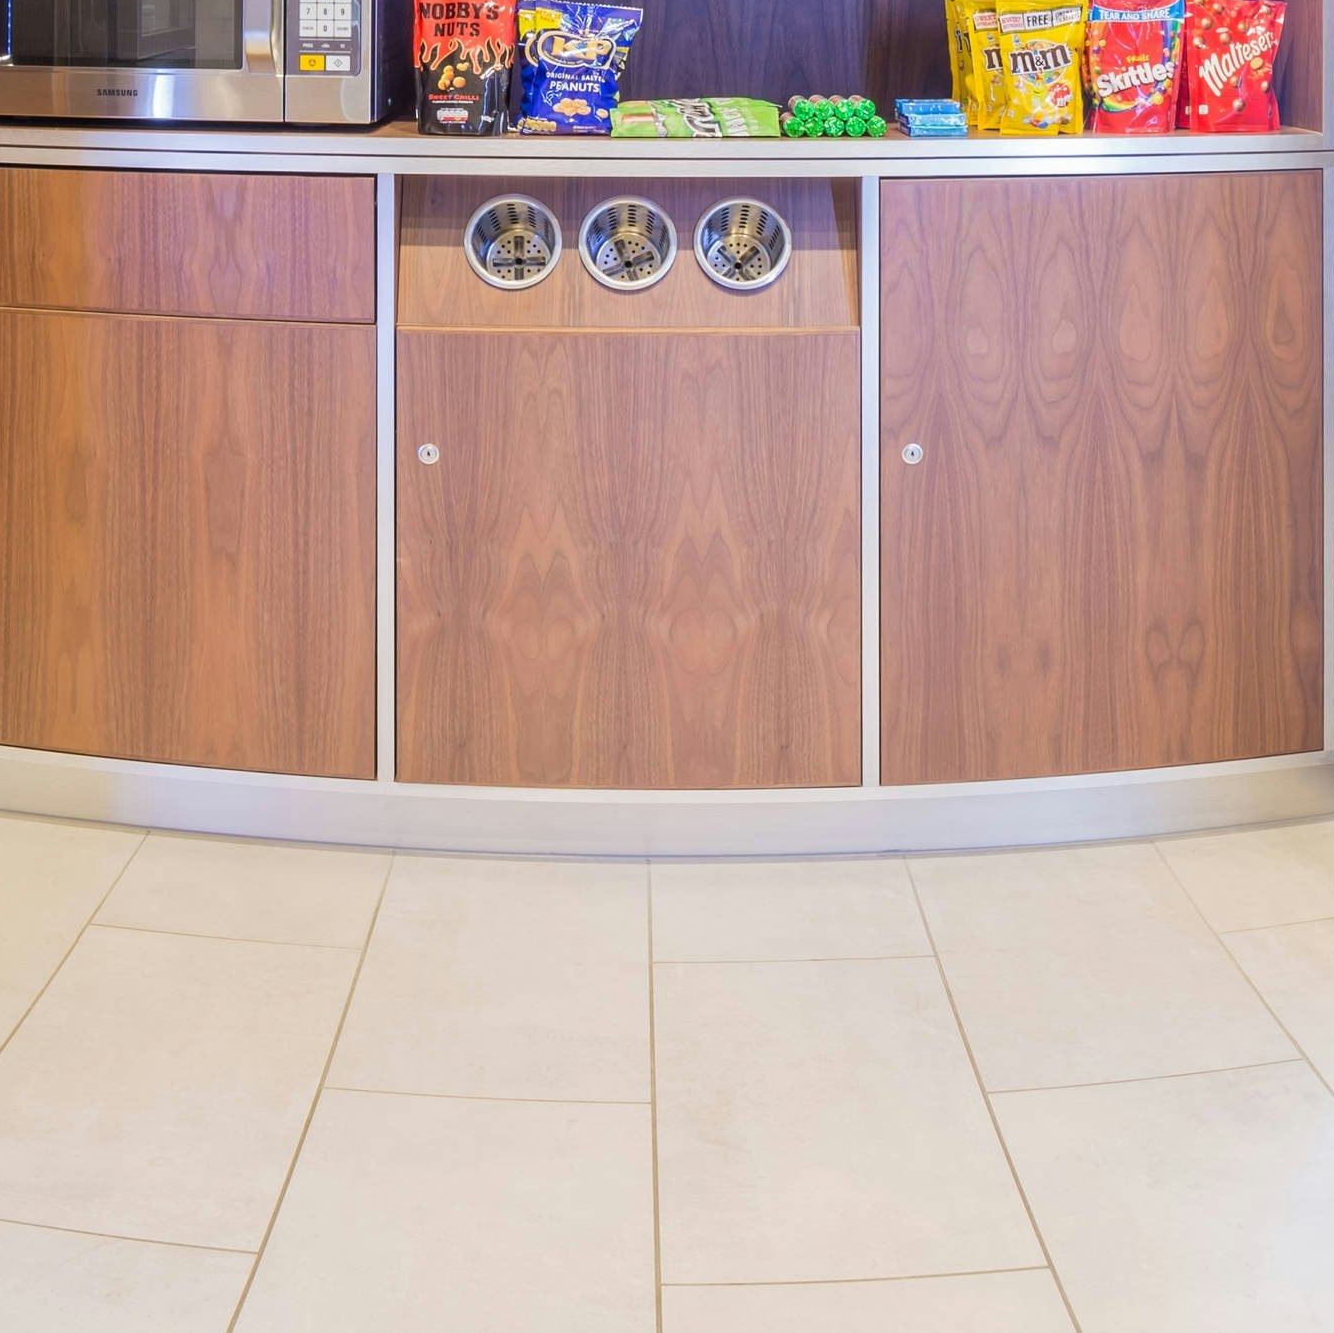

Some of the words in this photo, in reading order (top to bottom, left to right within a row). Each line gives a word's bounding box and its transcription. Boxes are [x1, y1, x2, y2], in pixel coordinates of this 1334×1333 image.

[419, 2, 499, 21] NOBBY'S
[1099, 10, 1120, 20] TEAR
[1121, 11, 1140, 20] AND
[1141, 9, 1171, 19] SHARE
[1027, 14, 1048, 26] FREE
[434, 22, 480, 37] NUTS
[552, 36, 611, 60] KP
[546, 72, 579, 81] ORIGINAL
[1096, 61, 1175, 98] Skittles
[96, 88, 139, 97] SAMSUNG
[549, 81, 601, 93] PEANUTS
